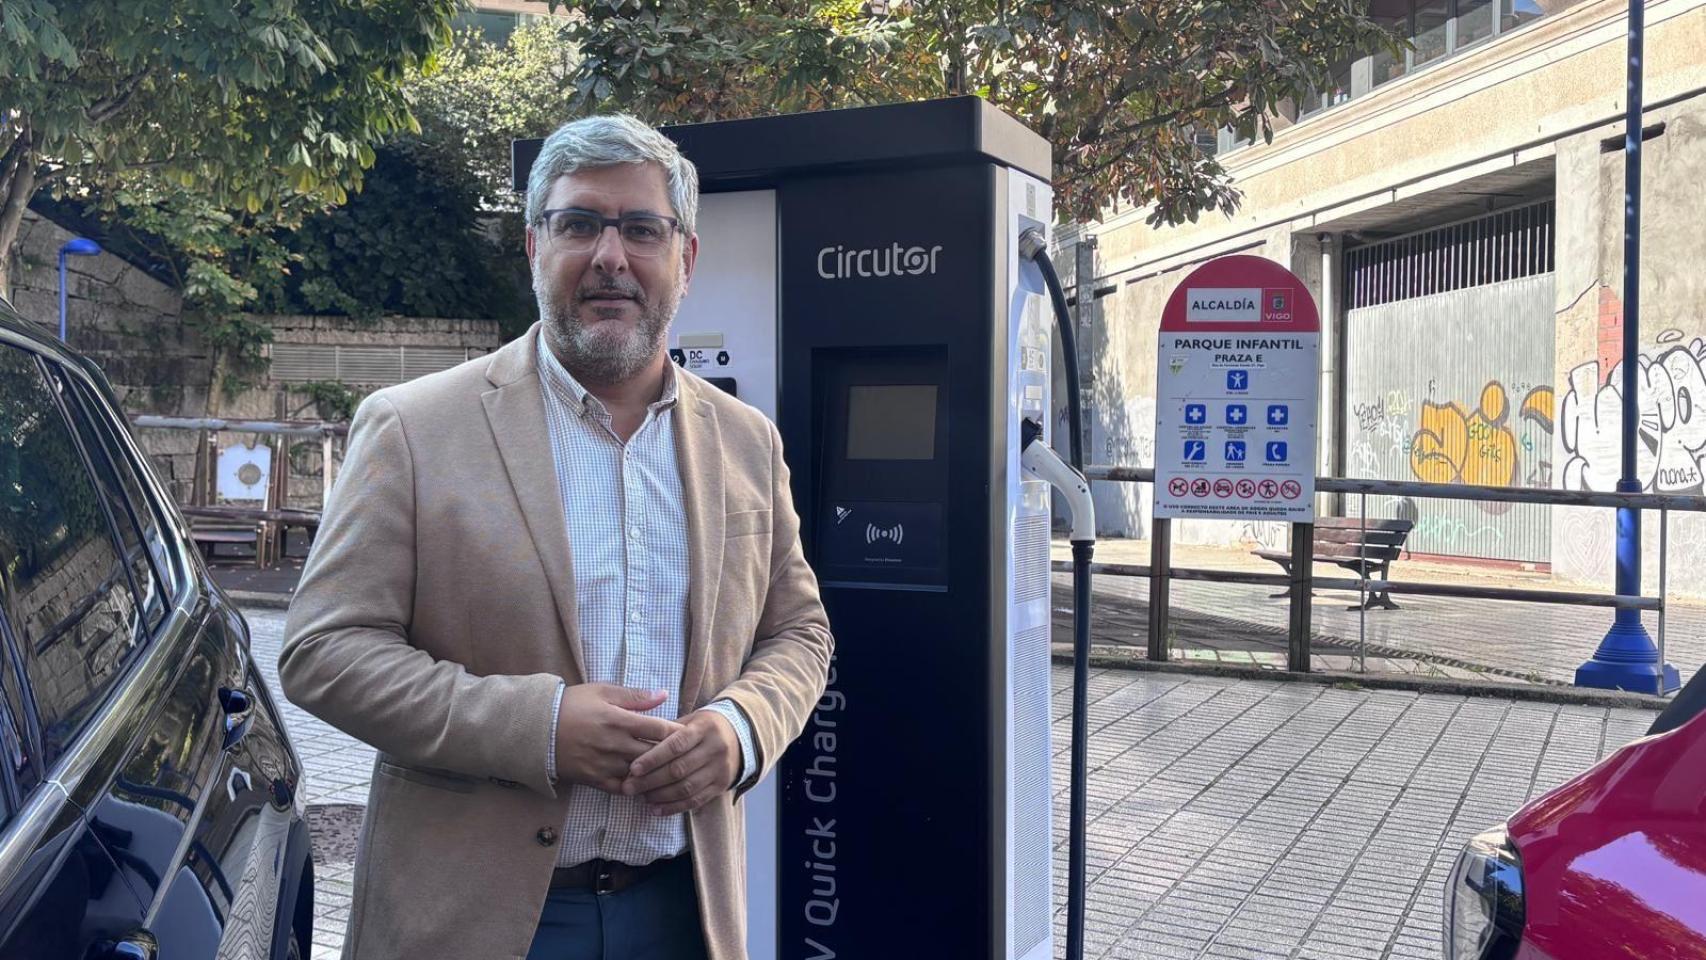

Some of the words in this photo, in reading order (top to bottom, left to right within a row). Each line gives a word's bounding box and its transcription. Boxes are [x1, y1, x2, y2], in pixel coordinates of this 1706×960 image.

[817, 242, 943, 279] Circutor
[1192, 298, 1255, 310] ALCALDÍA
[1174, 339, 1232, 350] PARQUE
[1236, 339, 1304, 350] INFANTIL
[690, 350, 703, 359] DC
[1214, 354, 1253, 363] PRAZA
[1256, 354, 1263, 363] E
[805, 655, 846, 802] Charg
[804, 817, 840, 926] Quick
